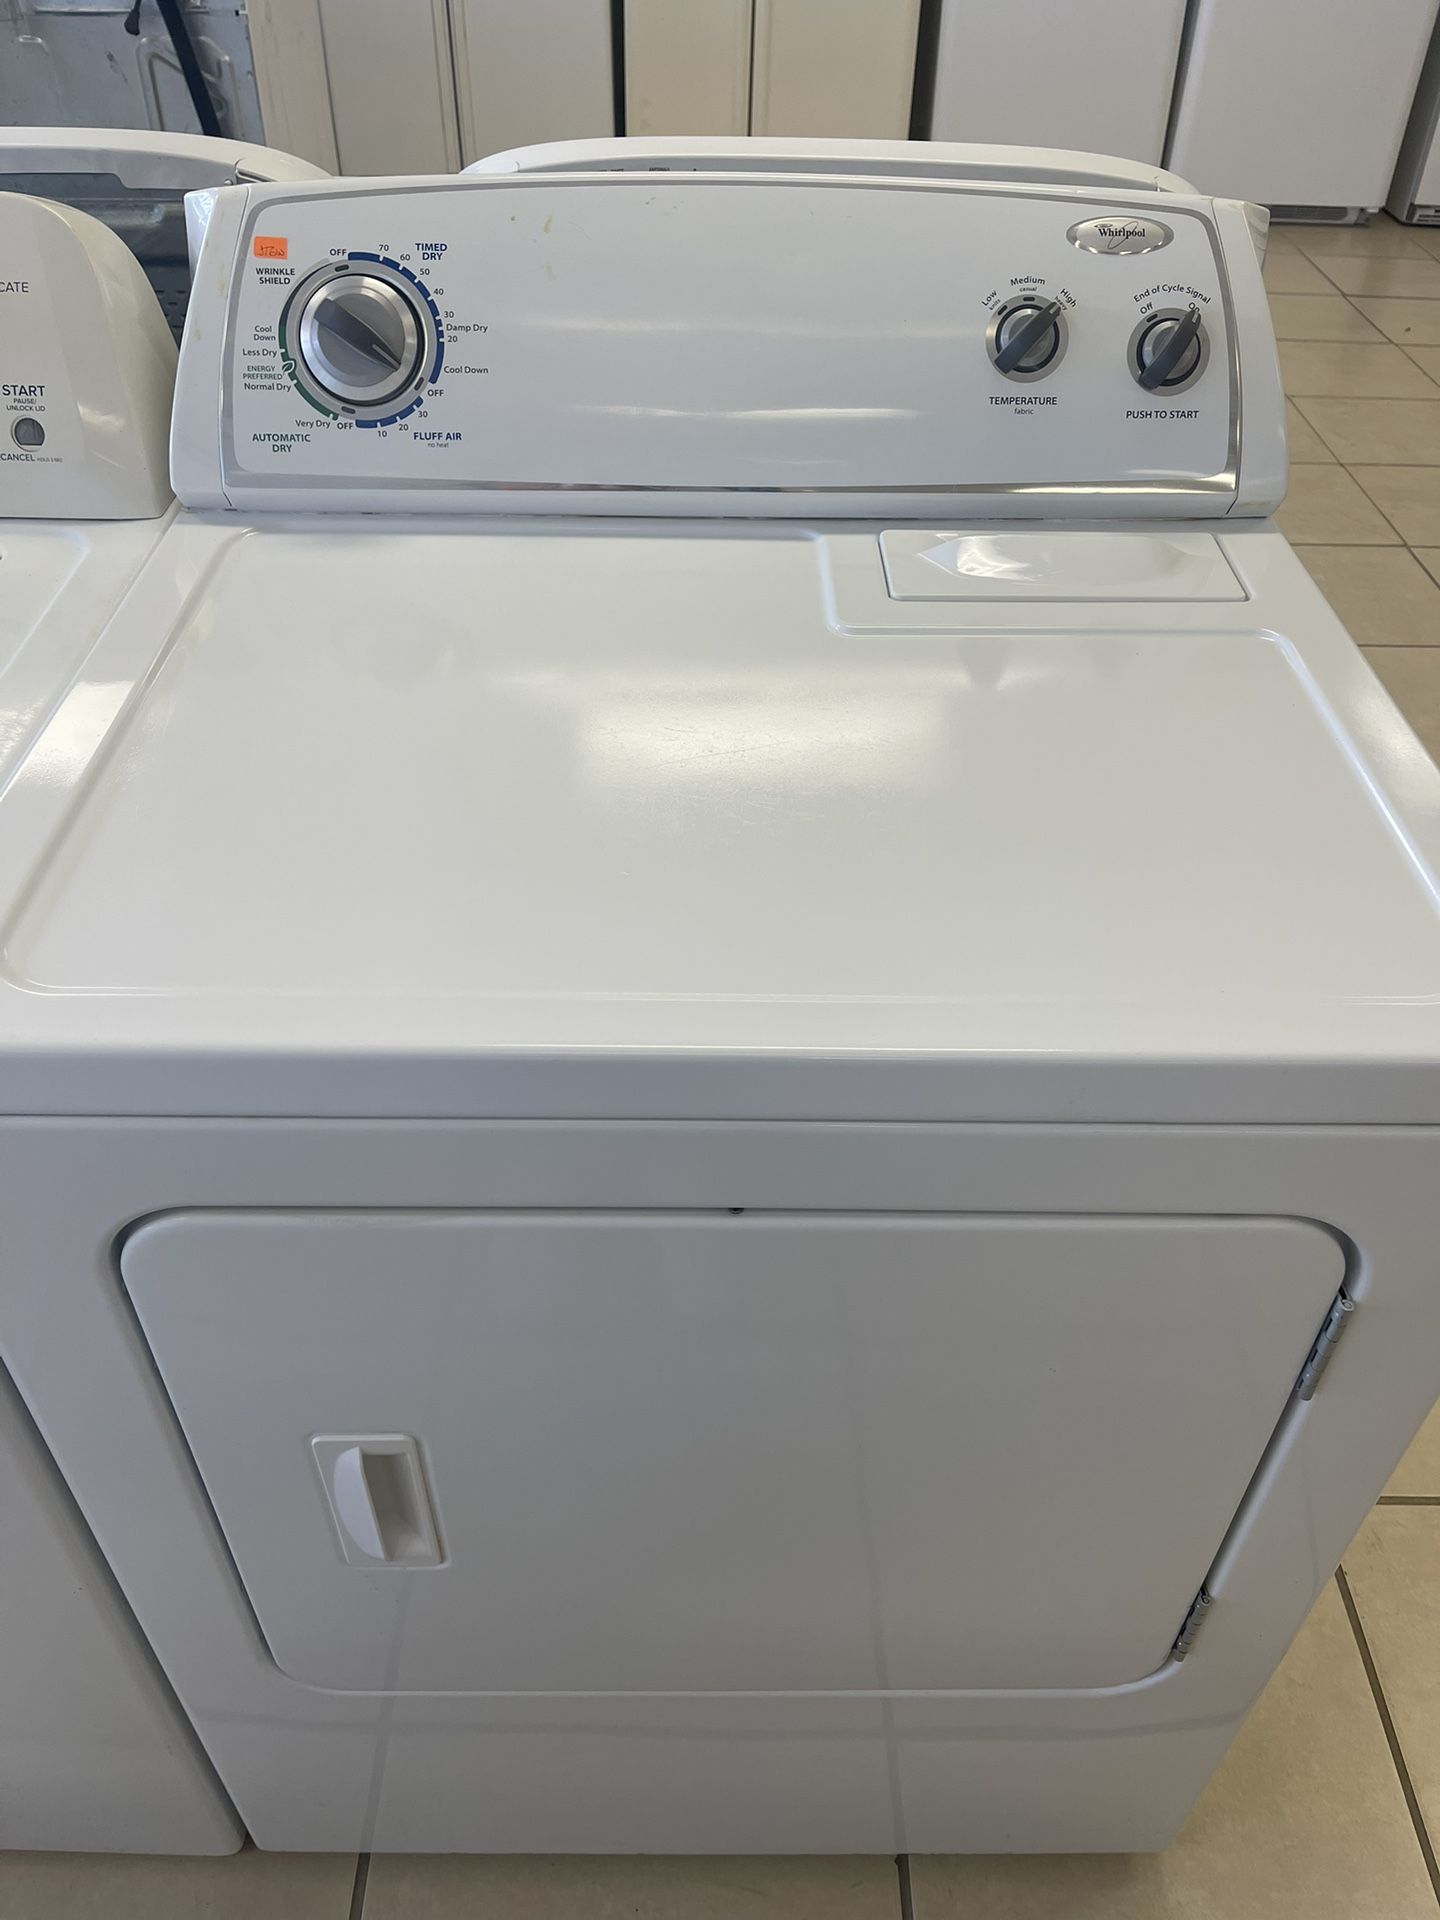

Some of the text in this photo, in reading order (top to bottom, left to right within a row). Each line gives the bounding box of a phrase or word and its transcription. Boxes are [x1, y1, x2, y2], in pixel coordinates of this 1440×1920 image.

[1098, 228, 1146, 239] Whirlpool
[416, 243, 447, 251] TIMED
[422, 252, 443, 260] DRY
[256, 268, 295, 276] WRINKLE
[1011, 276, 1045, 286] Medium
[1060, 288, 1078, 307] High
[1133, 284, 1211, 304] End of Cycle Signal
[981, 290, 997, 307] Low
[1140, 302, 1154, 314] Off
[1188, 302, 1200, 312] On
[446, 324, 488, 334] Damp Dry
[262, 349, 277, 357] Dry
[444, 366, 462, 374] Cool
[2, 385, 45, 396] START
[277, 384, 291, 392] Dry
[428, 389, 444, 397] OFF
[990, 397, 1057, 405] TEMPERATURE
[1126, 410, 1152, 418] PUSH
[296, 420, 331, 428] Very Dry
[337, 422, 353, 430] OFF
[252, 434, 311, 442] AUTOMATIC
[414, 432, 443, 440] FLUFF
[272, 444, 293, 452] DRY
[0, 454, 35, 462] CANCEL
